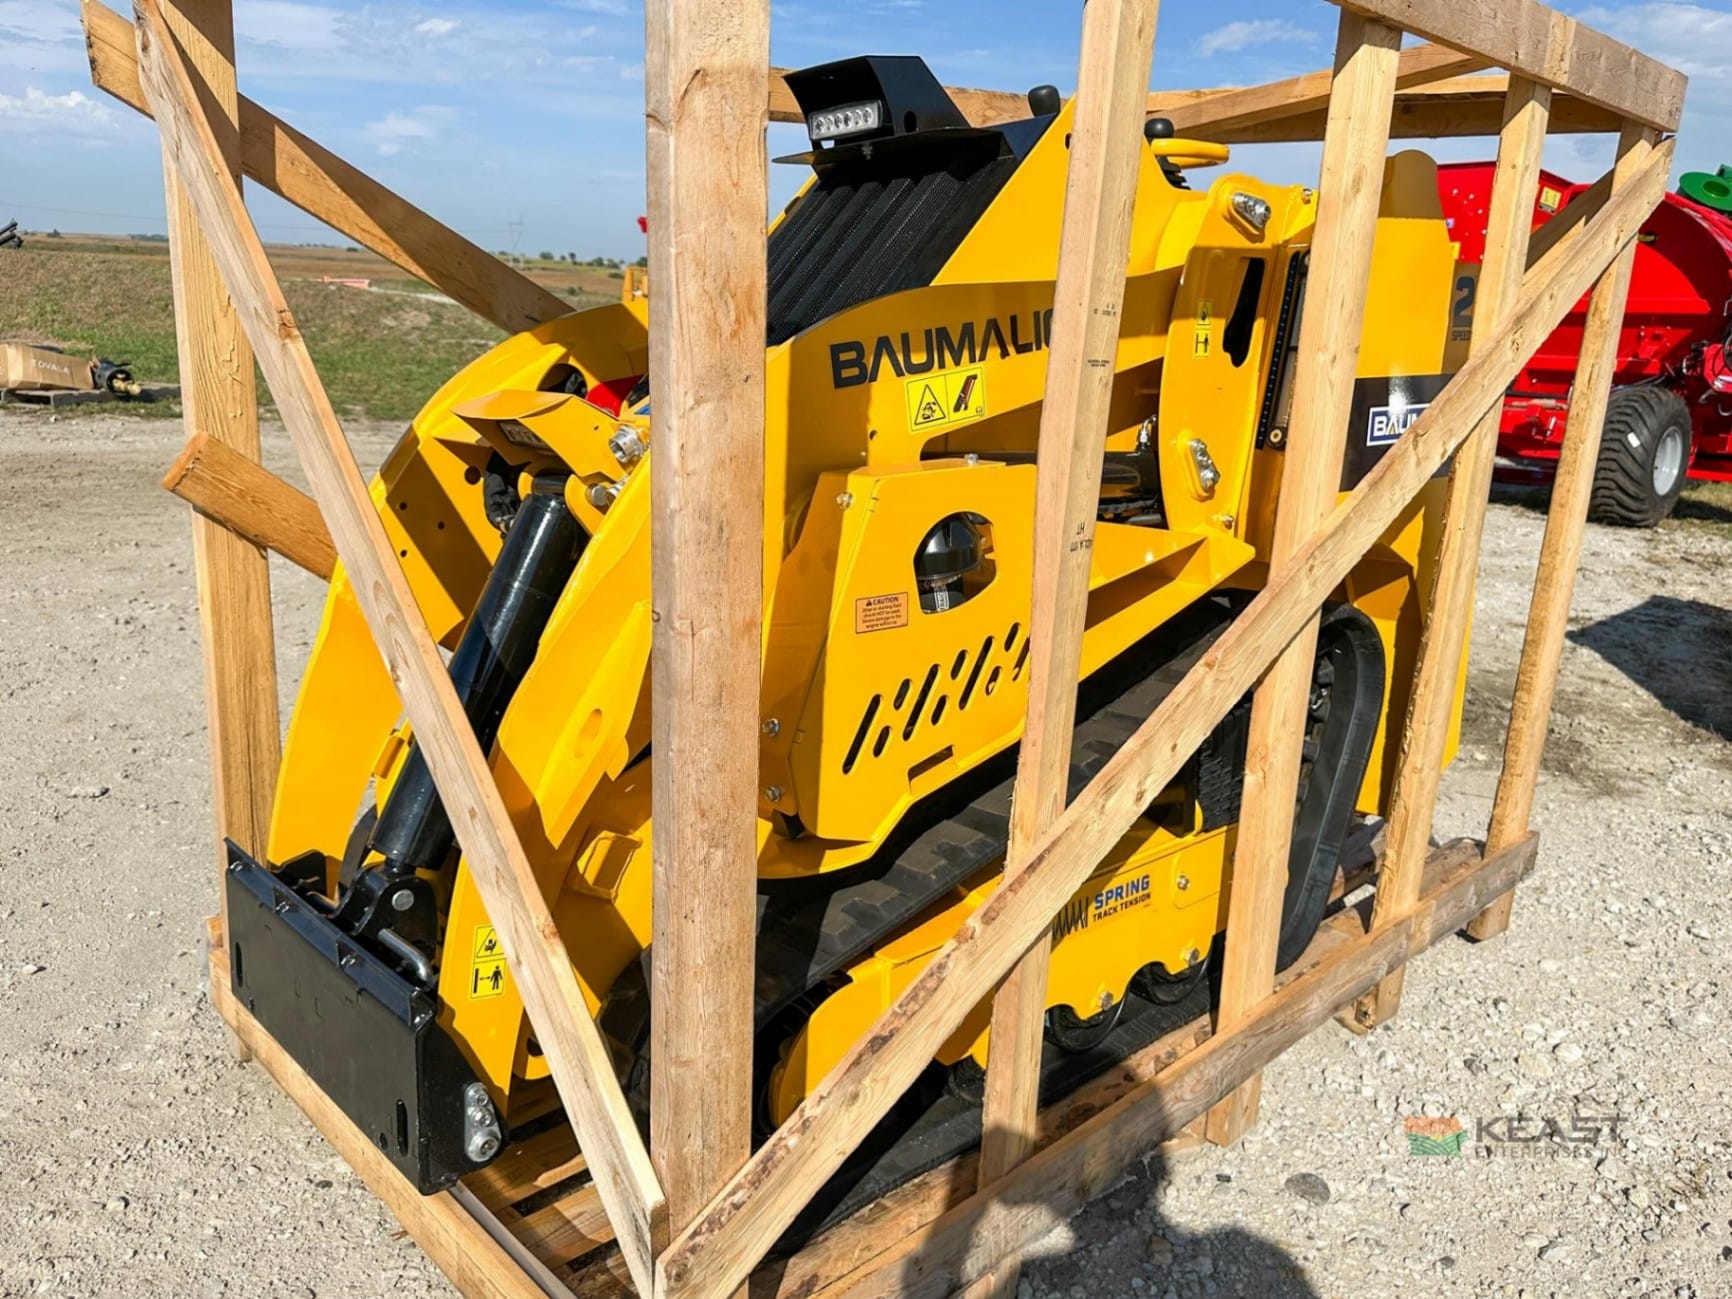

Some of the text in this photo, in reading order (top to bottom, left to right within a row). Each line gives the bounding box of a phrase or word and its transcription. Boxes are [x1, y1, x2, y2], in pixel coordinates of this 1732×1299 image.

[873, 596, 899, 606] CAUTION
[1093, 892, 1151, 922] TRACK TENSION
[1094, 874, 1150, 910] SPRING
